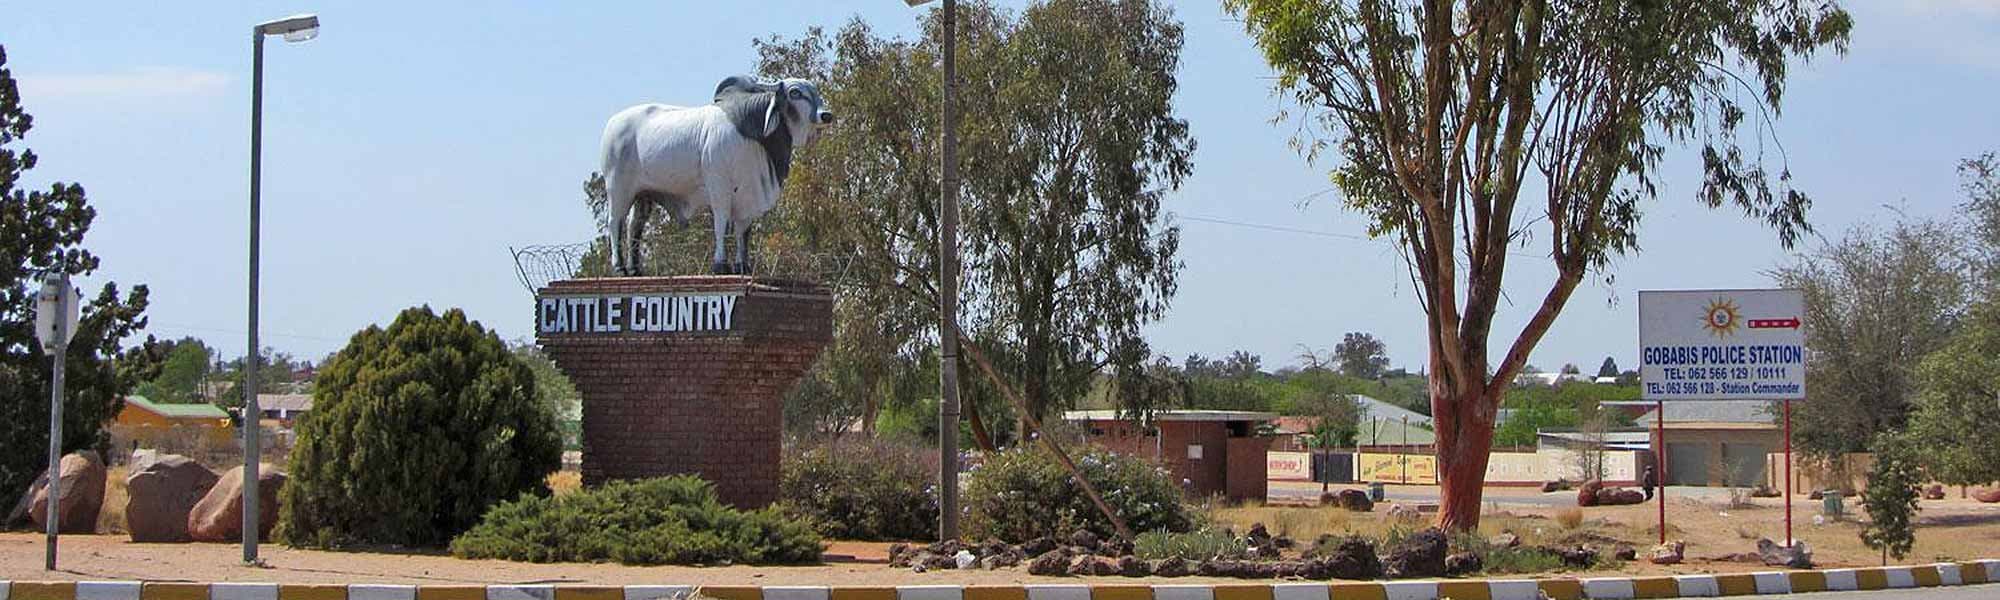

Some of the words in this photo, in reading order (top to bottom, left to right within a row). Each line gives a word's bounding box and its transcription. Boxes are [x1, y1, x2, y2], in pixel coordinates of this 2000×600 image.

[541, 298, 621, 333] CATTLE
[630, 295, 737, 332] COUNTRY
[1644, 346, 1698, 365] GOBABIS
[1702, 346, 1745, 364] POLICE
[1749, 345, 1801, 364] STATION
[1664, 368, 1686, 380] TEL:
[1688, 367, 1706, 379] 062
[1709, 367, 1727, 379] 566
[1730, 367, 1748, 379] 129
[1757, 367, 1785, 379] 10111
[1646, 382, 1665, 394] TEL:
[1666, 382, 1681, 394] 062
[1721, 382, 1750, 394] Station
[1752, 382, 1800, 394] Commander
